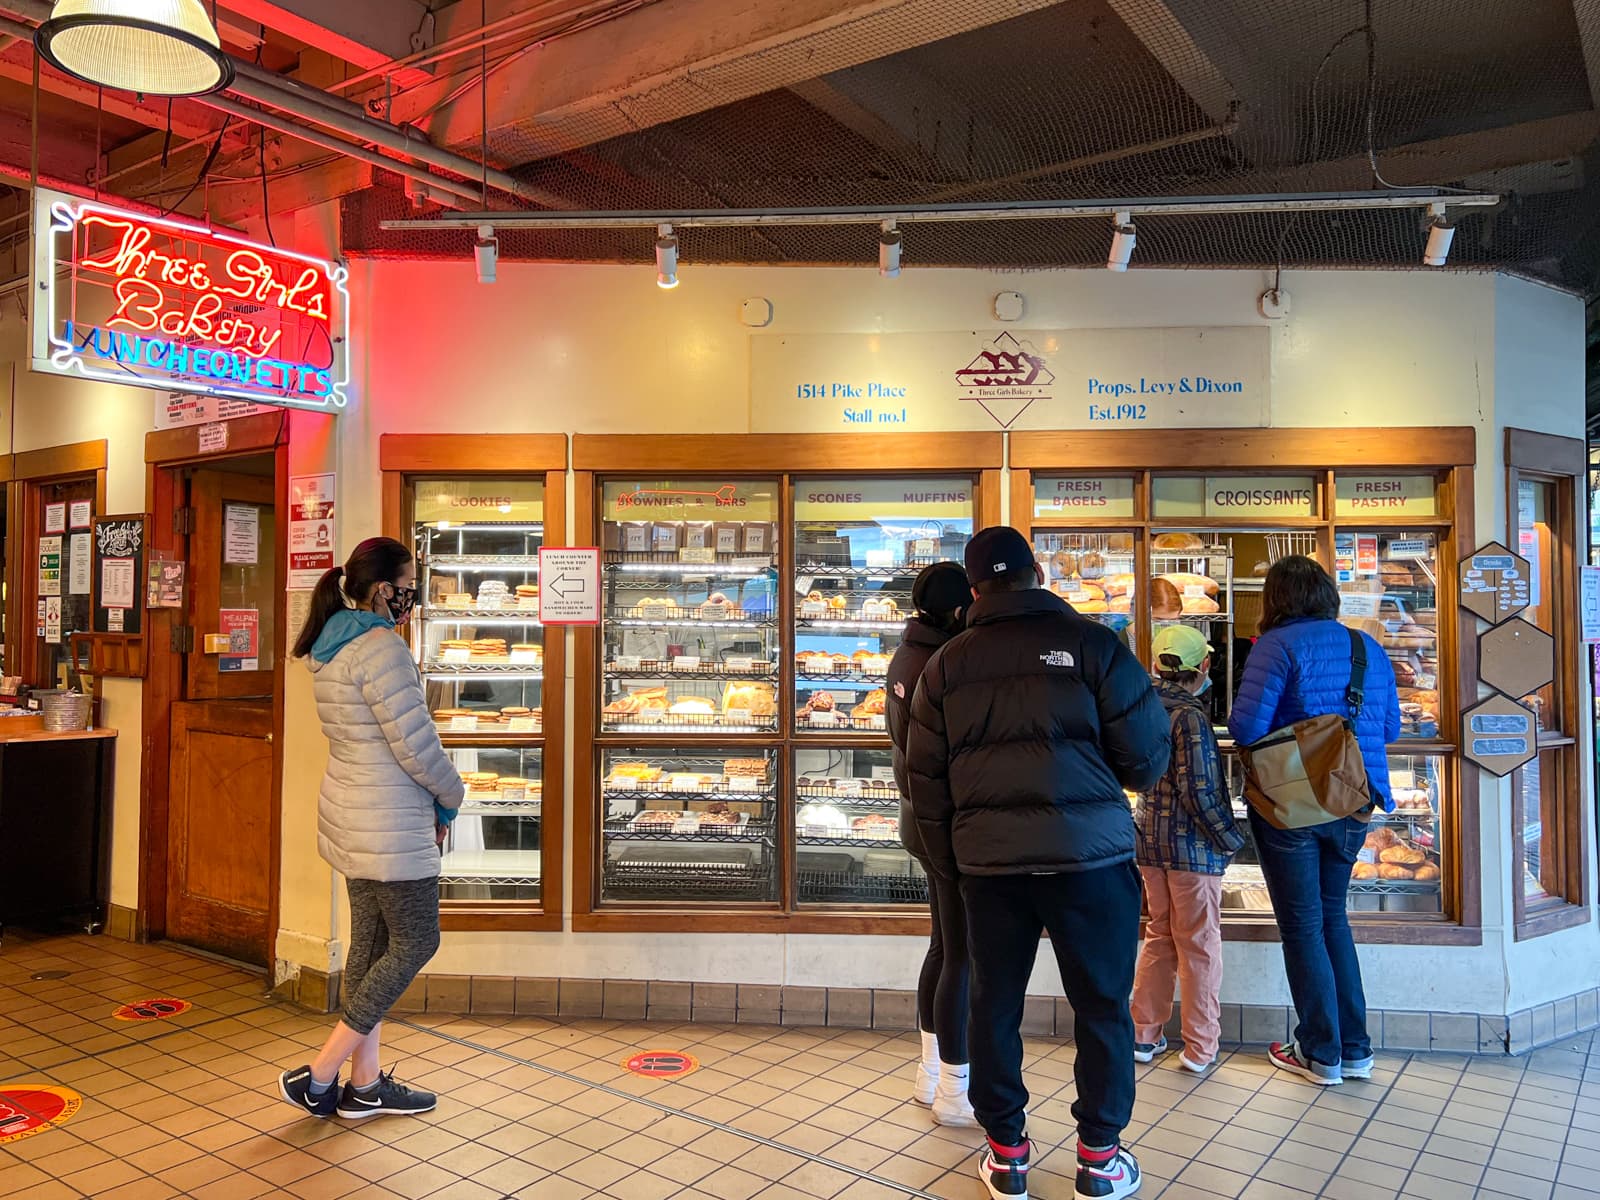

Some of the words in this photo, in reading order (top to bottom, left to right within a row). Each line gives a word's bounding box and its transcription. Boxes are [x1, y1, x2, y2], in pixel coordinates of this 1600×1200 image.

[81, 215, 213, 290] Three
[211, 249, 328, 320] Girls
[105, 277, 282, 358] Bakery
[797, 383, 826, 398] 1514
[832, 383, 861, 398] Pike
[867, 383, 907, 398] Place
[979, 388, 996, 396] Three
[996, 388, 1011, 396] Girls
[1011, 388, 1033, 396] Bakery
[1088, 377, 1137, 398] Props.
[1139, 377, 1175, 398] Levy
[1178, 378, 1194, 394] &
[1195, 377, 1243, 394] Dixon
[843, 408, 873, 423] Stall
[1057, 481, 1102, 491] FRESH
[1355, 481, 1401, 492] FRESH
[451, 496, 512, 507] COOKIES
[807, 493, 862, 503] SCONES
[904, 492, 966, 503] MUFFINS
[1053, 496, 1107, 506] BAGELS
[1214, 489, 1312, 506] CROISSANTS
[1351, 496, 1408, 508] PASTRY
